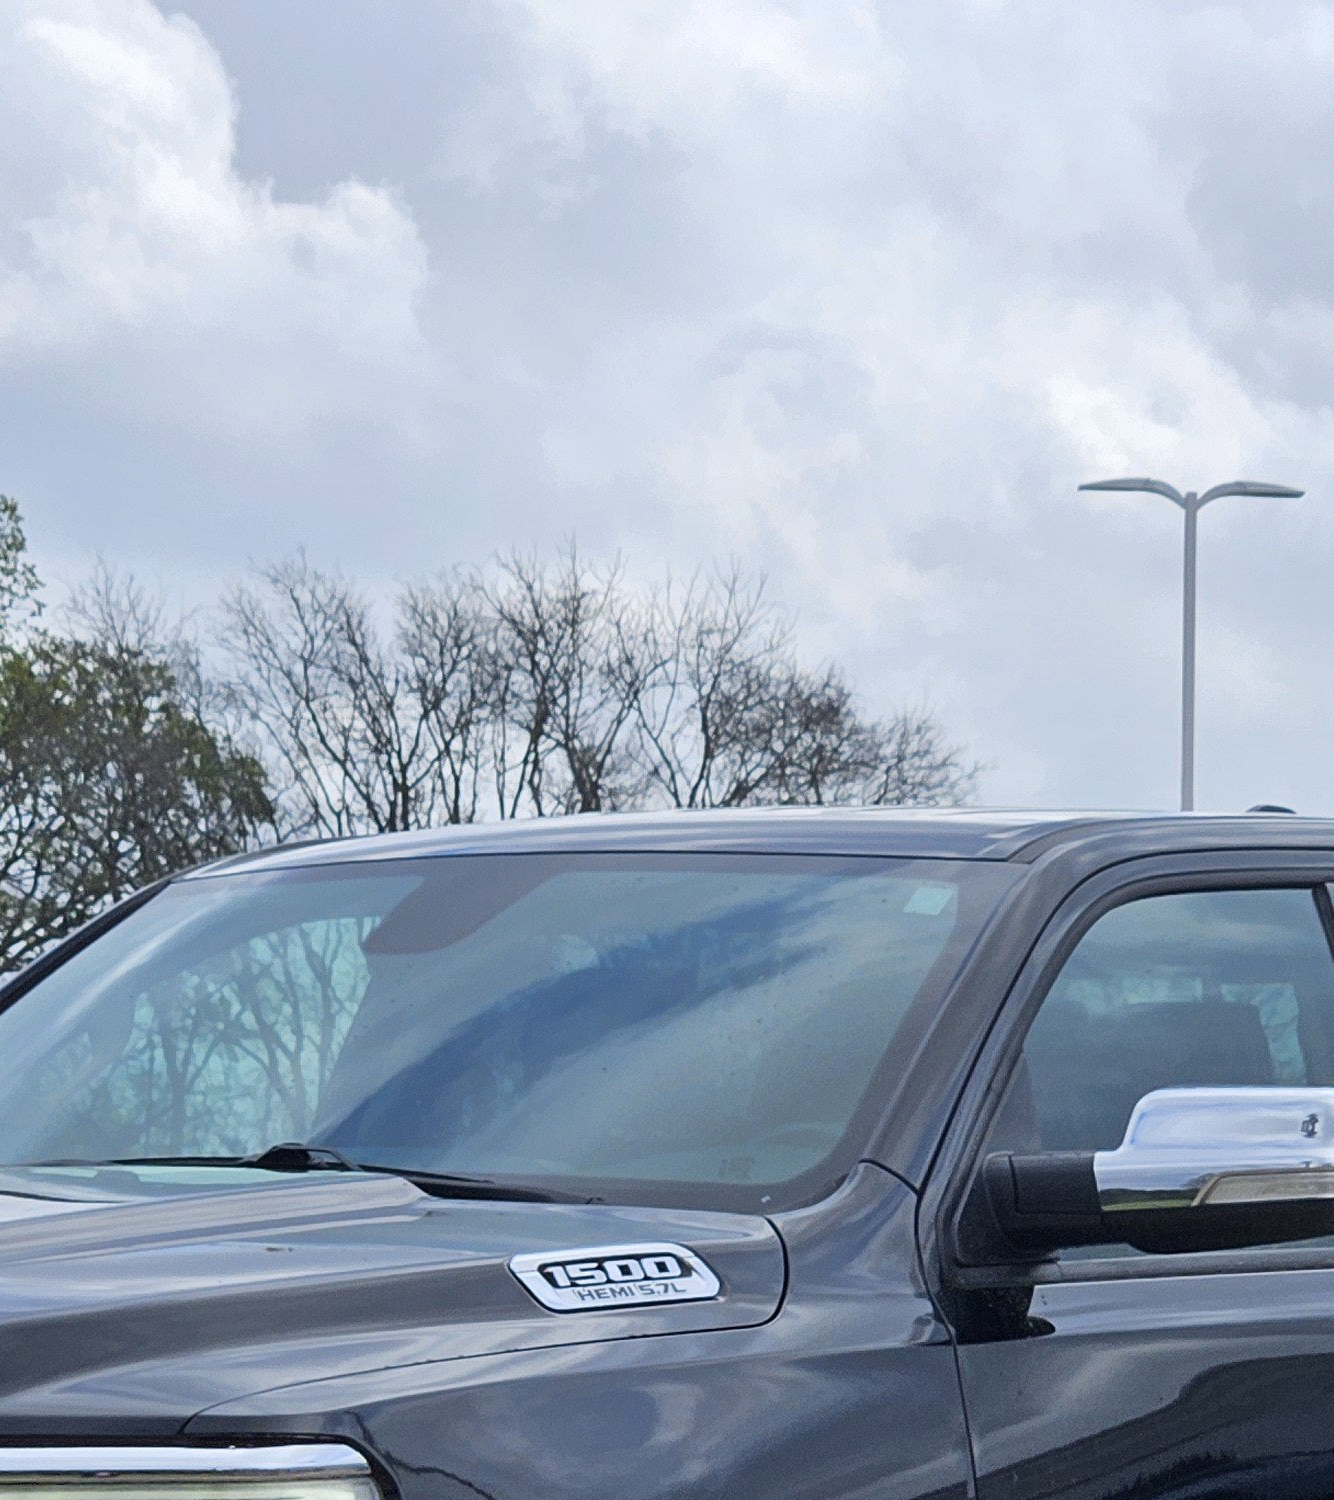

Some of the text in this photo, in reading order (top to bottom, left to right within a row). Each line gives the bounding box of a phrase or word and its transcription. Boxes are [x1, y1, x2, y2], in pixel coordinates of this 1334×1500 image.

[543, 1256, 682, 1287] 1500
[577, 1281, 687, 1301] HEMI 5.7L
